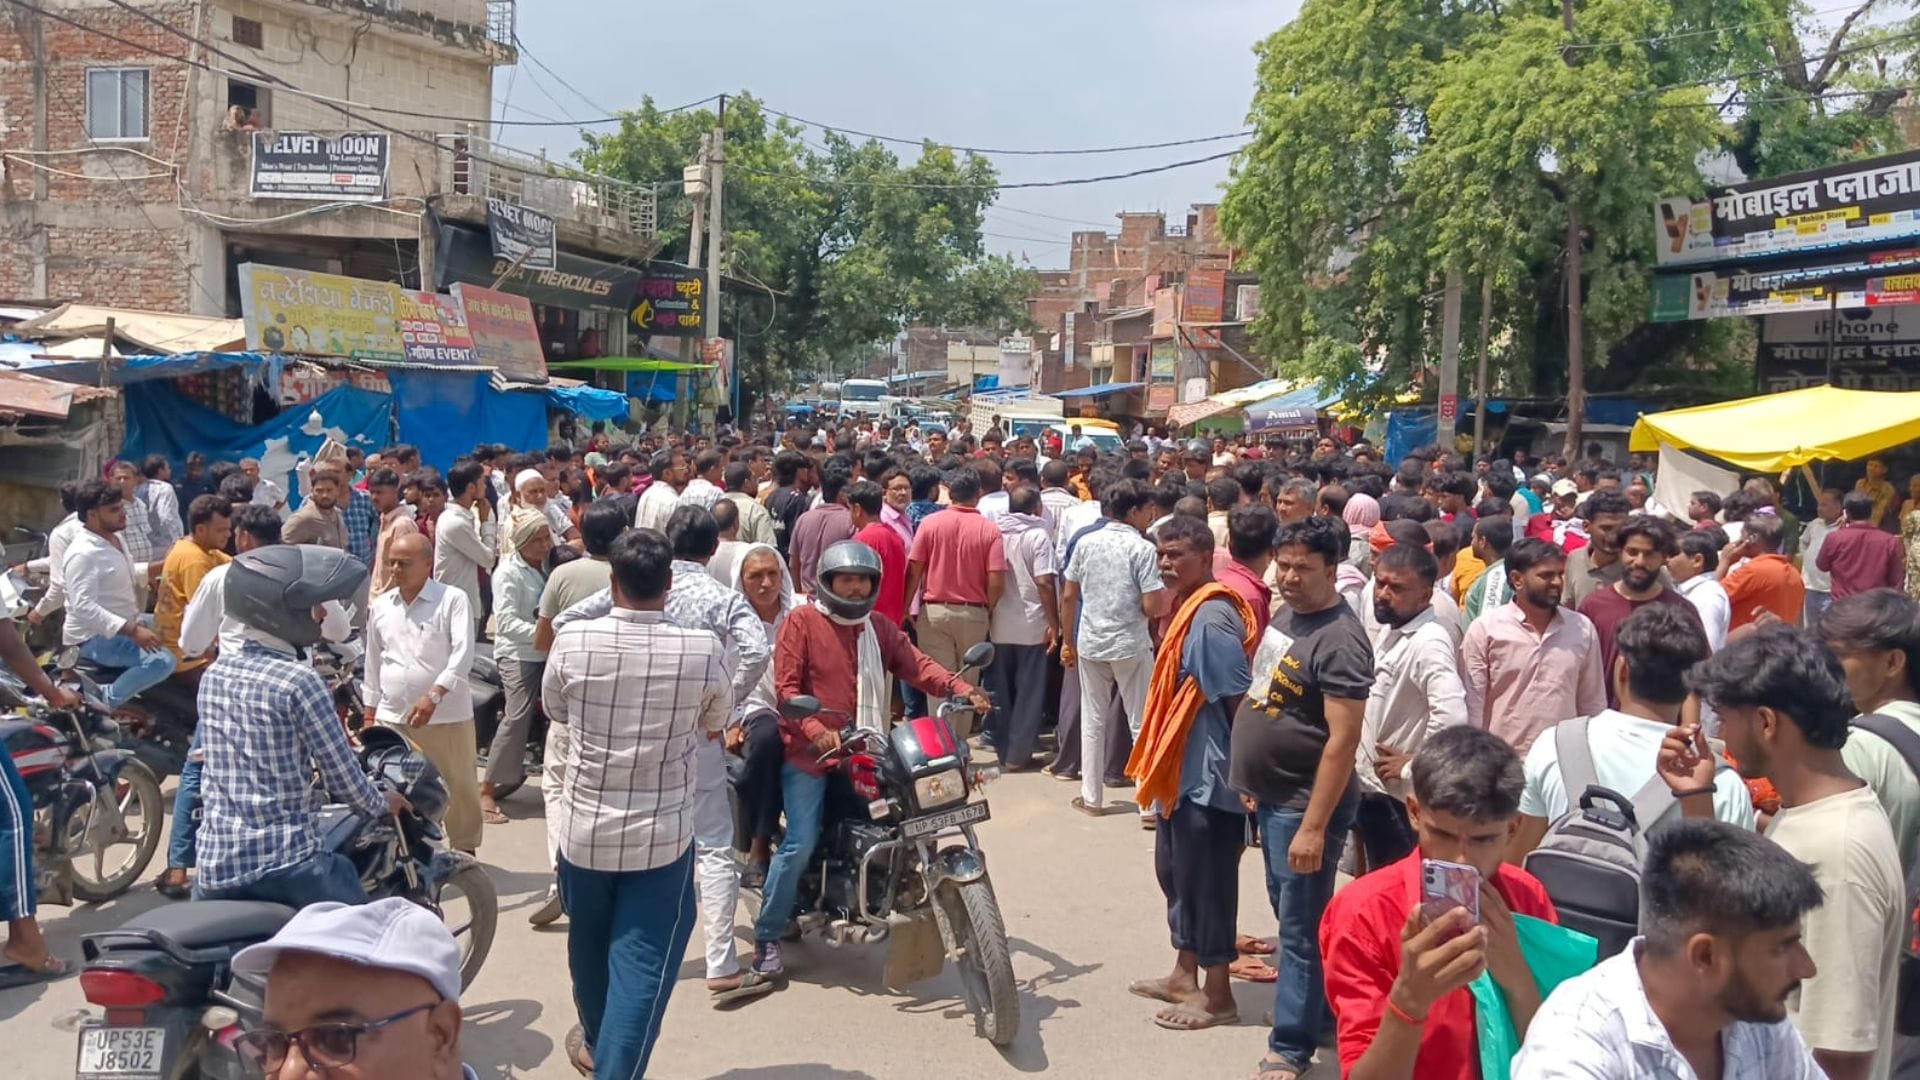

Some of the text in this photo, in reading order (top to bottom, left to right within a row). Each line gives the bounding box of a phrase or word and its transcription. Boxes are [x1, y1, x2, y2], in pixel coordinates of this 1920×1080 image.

[263, 136, 379, 155] VELVET MOON
[1714, 161, 1920, 221] मोबाइल प्लाजा
[489, 200, 520, 224] ELVET
[1800, 213, 1824, 224] Mobile
[1826, 209, 1847, 219] Store
[537, 270, 613, 296] HERCULES
[1814, 319, 1899, 336] iPhone
[436, 348, 470, 361] EVENT
[1267, 409, 1302, 420] Amul
[96, 1030, 156, 1050] UP53E
[94, 1051, 153, 1070] J8502
